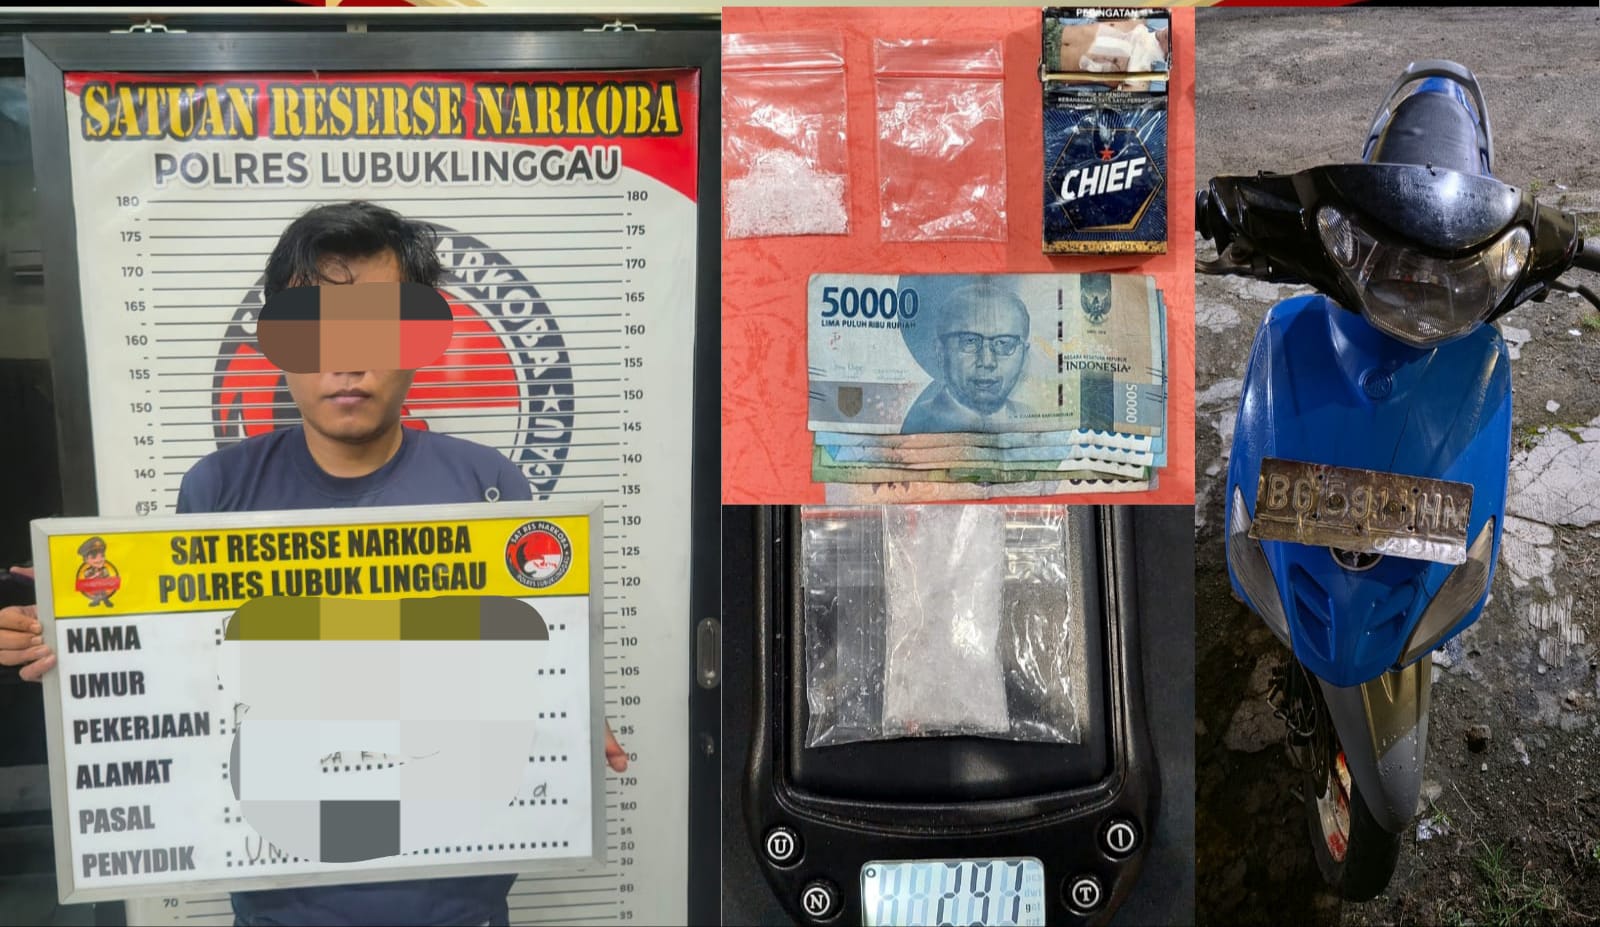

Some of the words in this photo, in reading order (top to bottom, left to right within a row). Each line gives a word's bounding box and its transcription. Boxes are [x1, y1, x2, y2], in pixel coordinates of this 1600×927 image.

[83, 80, 256, 140] SATUAN
[270, 79, 464, 138] RESERSE
[475, 77, 682, 138] NARKOBA
[154, 151, 309, 186] POLRES
[322, 148, 620, 184] LUBUKLINGGAU
[1061, 157, 1147, 201] CHIEF
[116, 195, 140, 207] 180
[627, 190, 648, 202] 180
[626, 224, 646, 236] 175
[120, 231, 142, 243] 175
[625, 258, 646, 270] 170
[121, 266, 144, 278] 170
[625, 292, 645, 303] 165
[821, 286, 919, 320] 50000
[124, 301, 146, 312] 165
[624, 324, 646, 336] 160
[821, 319, 840, 328] LIMA
[842, 320, 867, 329] PULUH
[868, 321, 885, 330] RIBU
[125, 335, 148, 346] 160
[623, 357, 643, 368] 155
[1066, 360, 1129, 373] INDONESIA
[129, 369, 151, 380] 155
[623, 389, 644, 400] 150
[130, 402, 153, 414] 150
[1126, 383, 1138, 424] 50000
[622, 421, 642, 432] 145
[133, 436, 155, 446] 145
[622, 453, 643, 464] 140
[134, 468, 156, 479] 140
[622, 484, 641, 495] 135
[621, 515, 642, 526] 130
[171, 535, 220, 566] SAT
[226, 530, 342, 564] RESERSE
[348, 525, 472, 558] NARKOBA
[621, 546, 640, 556] 125
[158, 571, 264, 604] POLRES
[271, 565, 363, 598] LUBUK
[369, 561, 487, 595] LINGGAU
[621, 577, 641, 587] 120
[620, 606, 638, 617] 115
[67, 625, 142, 653] NAMA
[620, 636, 638, 647] 110
[620, 666, 640, 677] 105
[70, 670, 146, 699] UMUR
[620, 696, 641, 706] 100
[73, 711, 211, 745] PEKERJAAN
[620, 725, 634, 736] 95
[76, 759, 173, 790] ALAMAT
[79, 805, 156, 834] PASAL
[774, 839, 788, 855] U
[82, 846, 196, 878] PENYIDIK
[1080, 887, 1092, 902] T
[163, 897, 179, 909] 70
[810, 894, 824, 910] N
